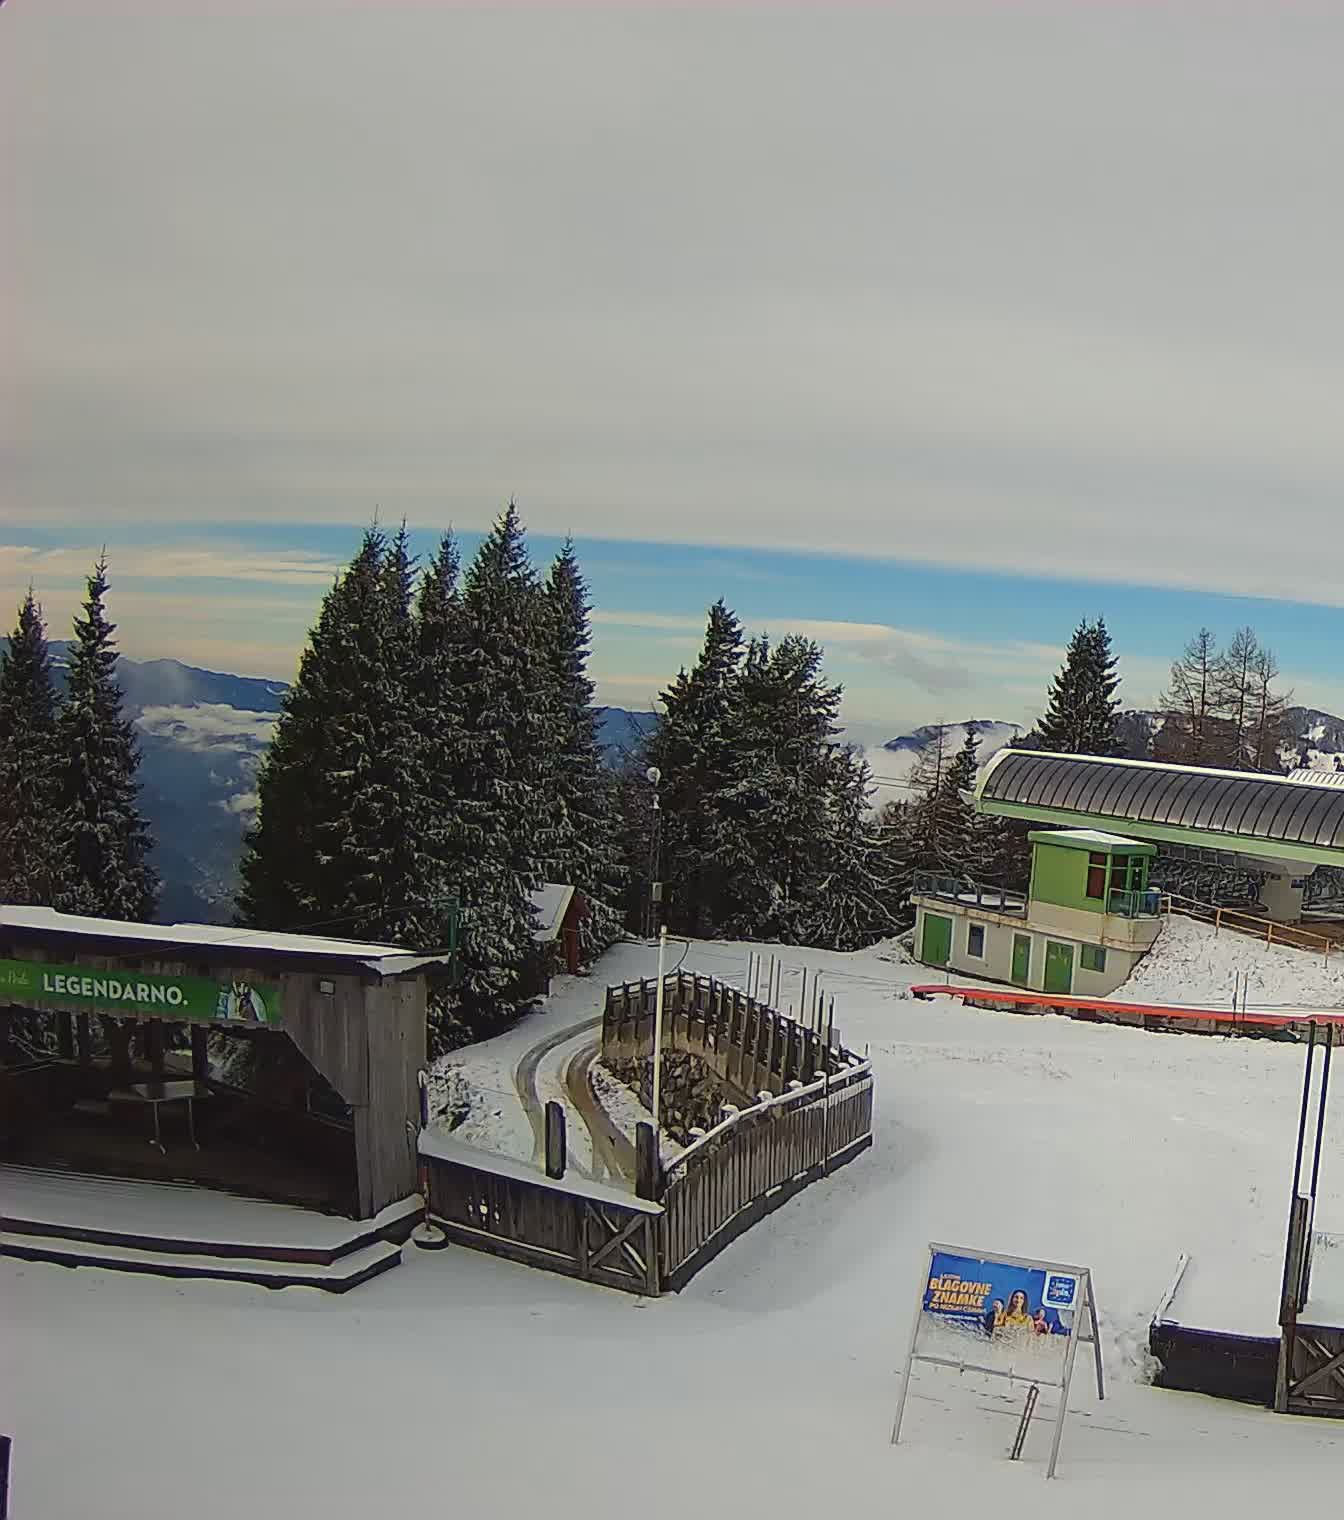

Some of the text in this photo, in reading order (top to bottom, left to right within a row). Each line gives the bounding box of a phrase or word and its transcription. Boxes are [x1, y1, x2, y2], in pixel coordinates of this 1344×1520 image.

[43, 973, 189, 1006] LEGENDARNO.
[929, 1278, 992, 1296] BLAGOVNE
[931, 1291, 985, 1308] ZNAMKE
